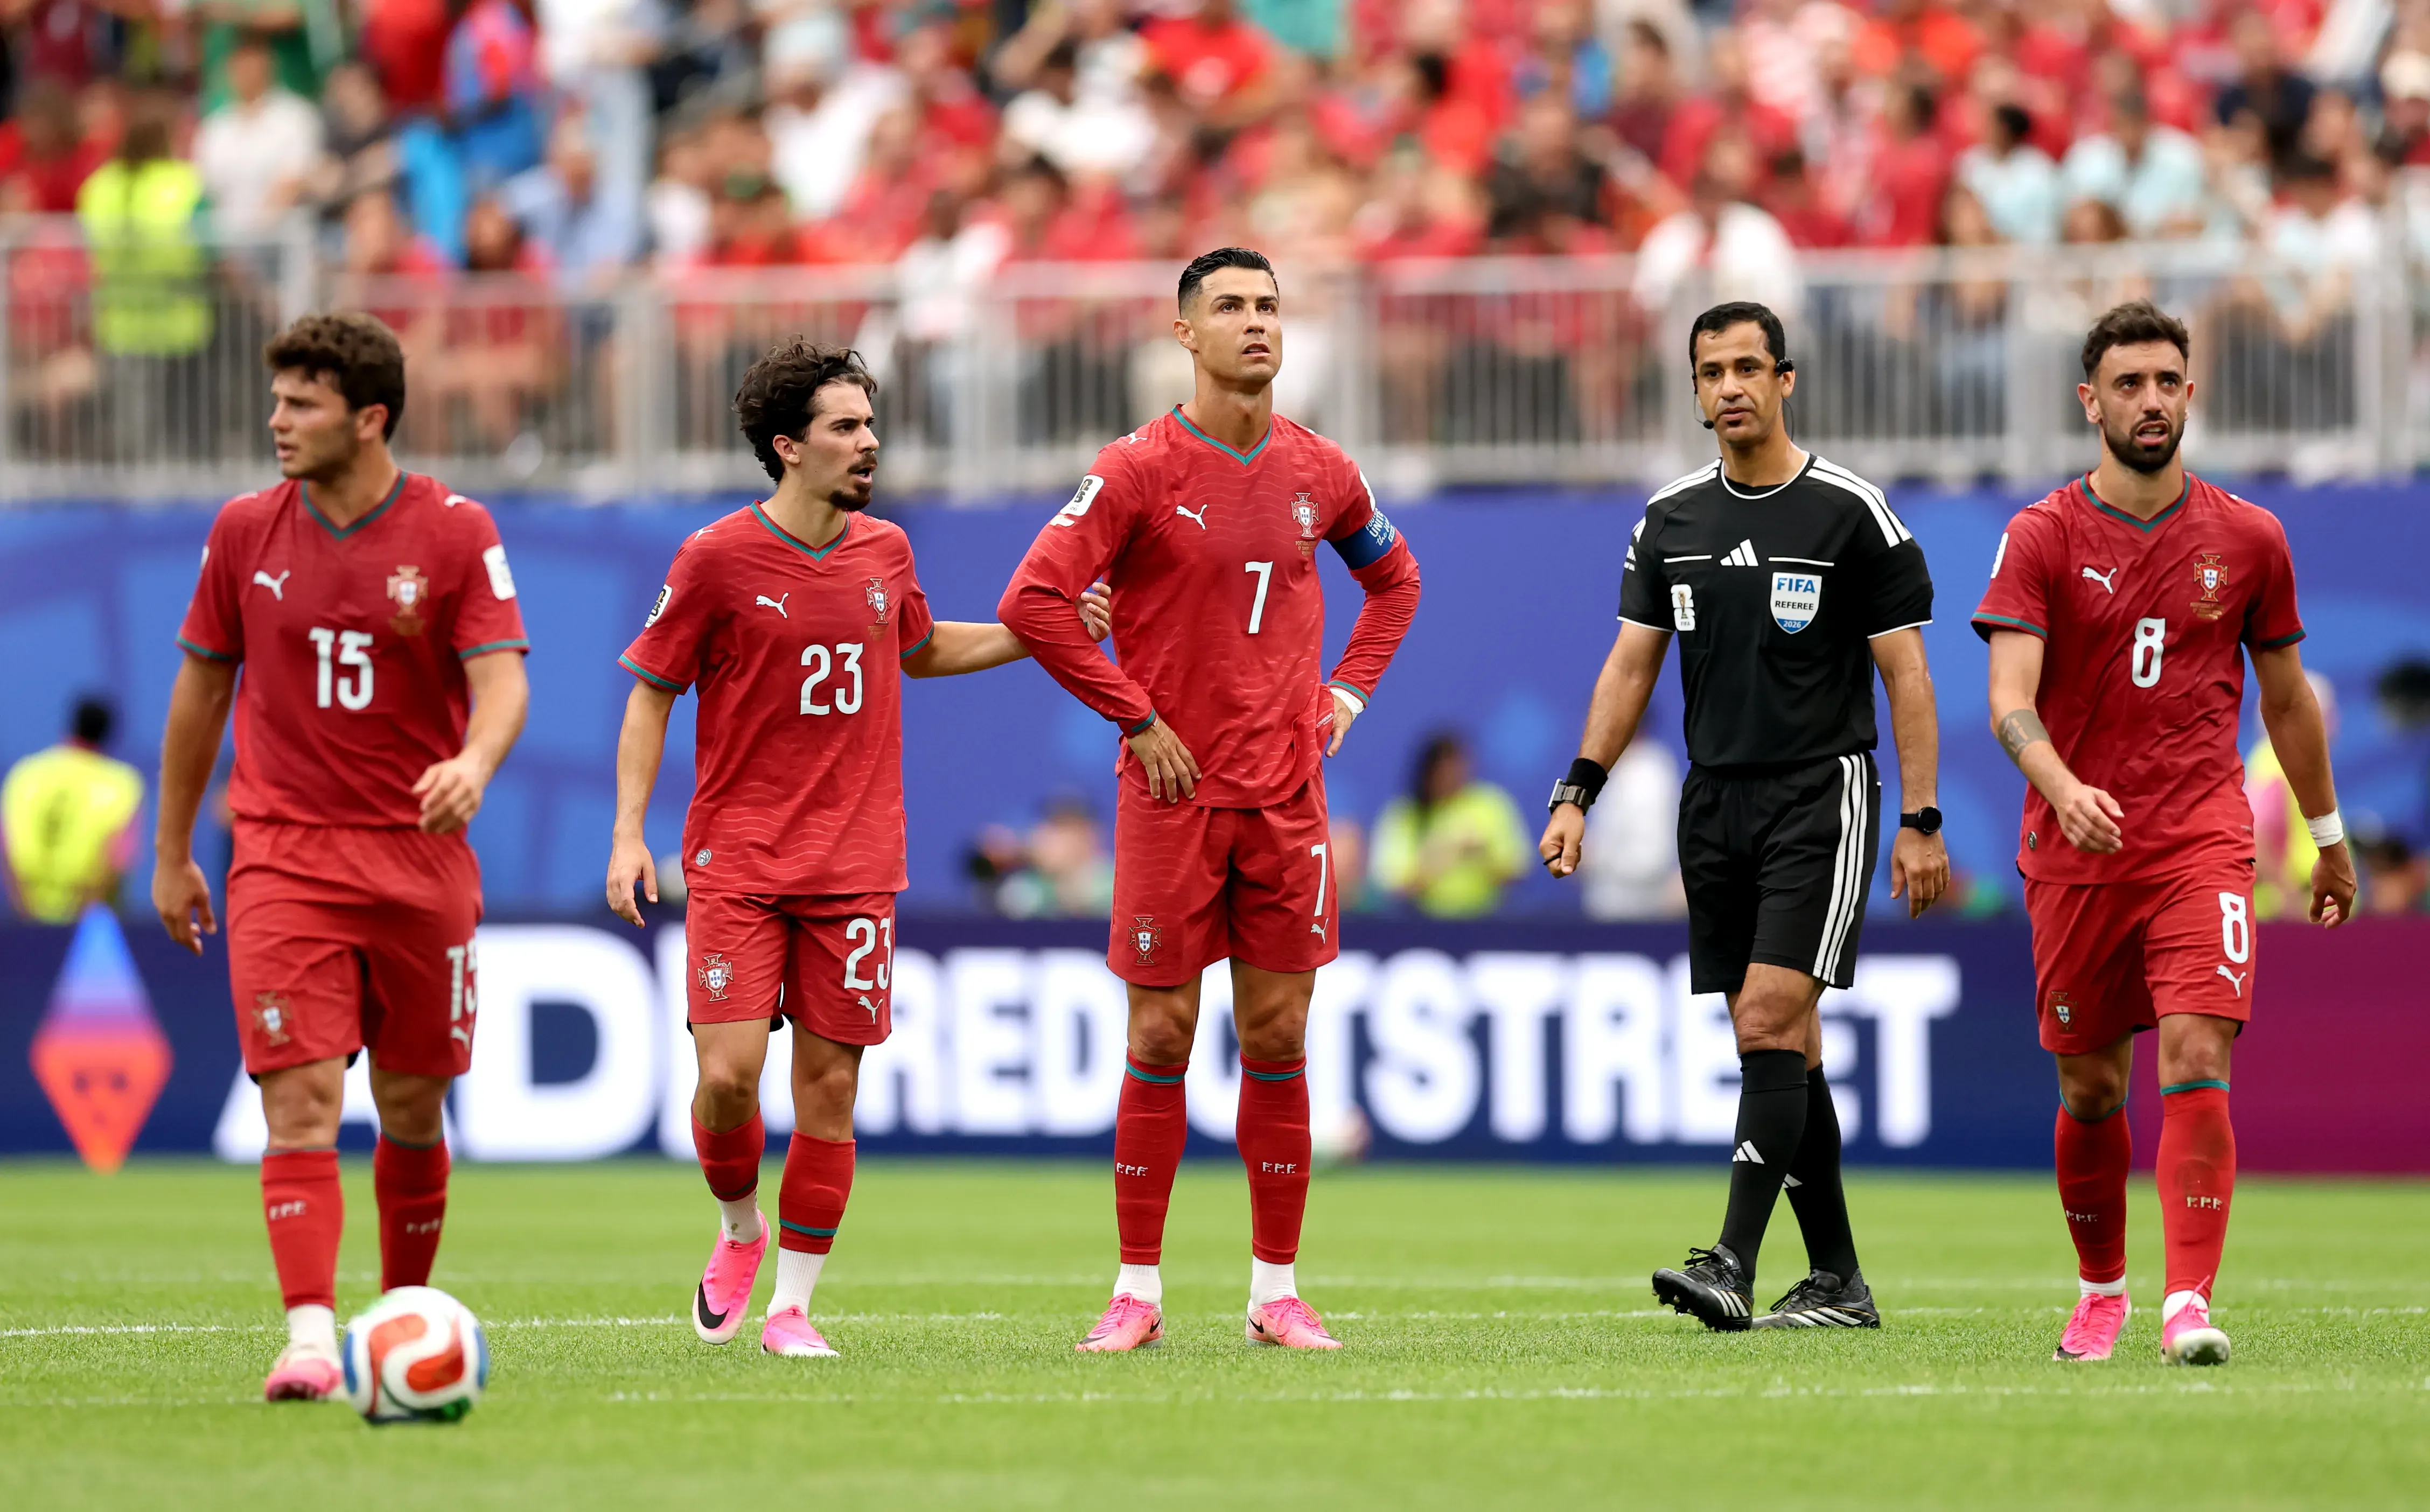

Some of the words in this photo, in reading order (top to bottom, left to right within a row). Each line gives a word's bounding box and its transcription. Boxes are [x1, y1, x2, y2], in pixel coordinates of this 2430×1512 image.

[1245, 561, 1273, 634] 7
[1775, 600, 1814, 611] REFEREE
[1777, 578, 1815, 593] FIFA
[1783, 620, 1801, 628] 2026
[2132, 617, 2166, 688] 8
[309, 627, 374, 710] 15
[800, 642, 863, 716] 23
[1311, 841, 1326, 917] 7
[844, 916, 891, 990] 23
[2218, 892, 2249, 964] 8
